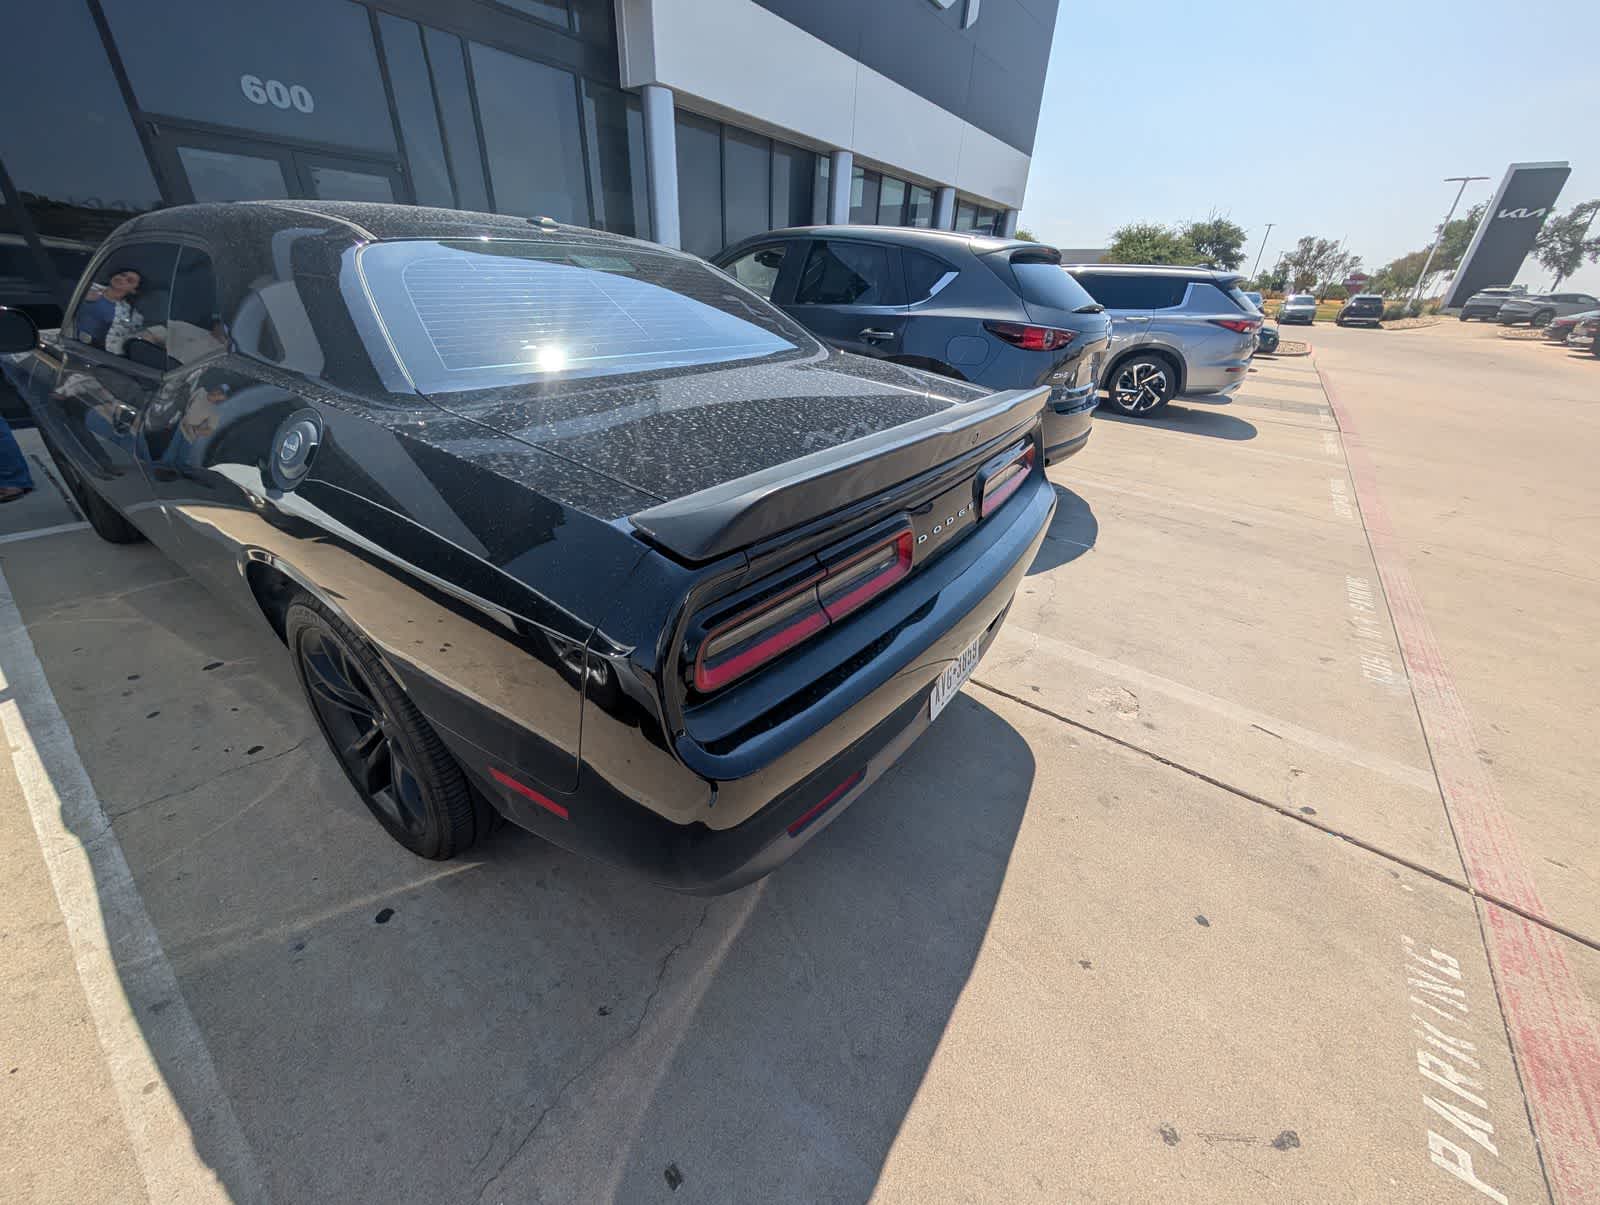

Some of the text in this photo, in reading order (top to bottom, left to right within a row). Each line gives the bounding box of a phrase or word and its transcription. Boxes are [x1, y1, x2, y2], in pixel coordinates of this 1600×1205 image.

[241, 75, 314, 112] 600
[1498, 207, 1547, 218] KIA
[1401, 934, 1508, 1205] PARKING
